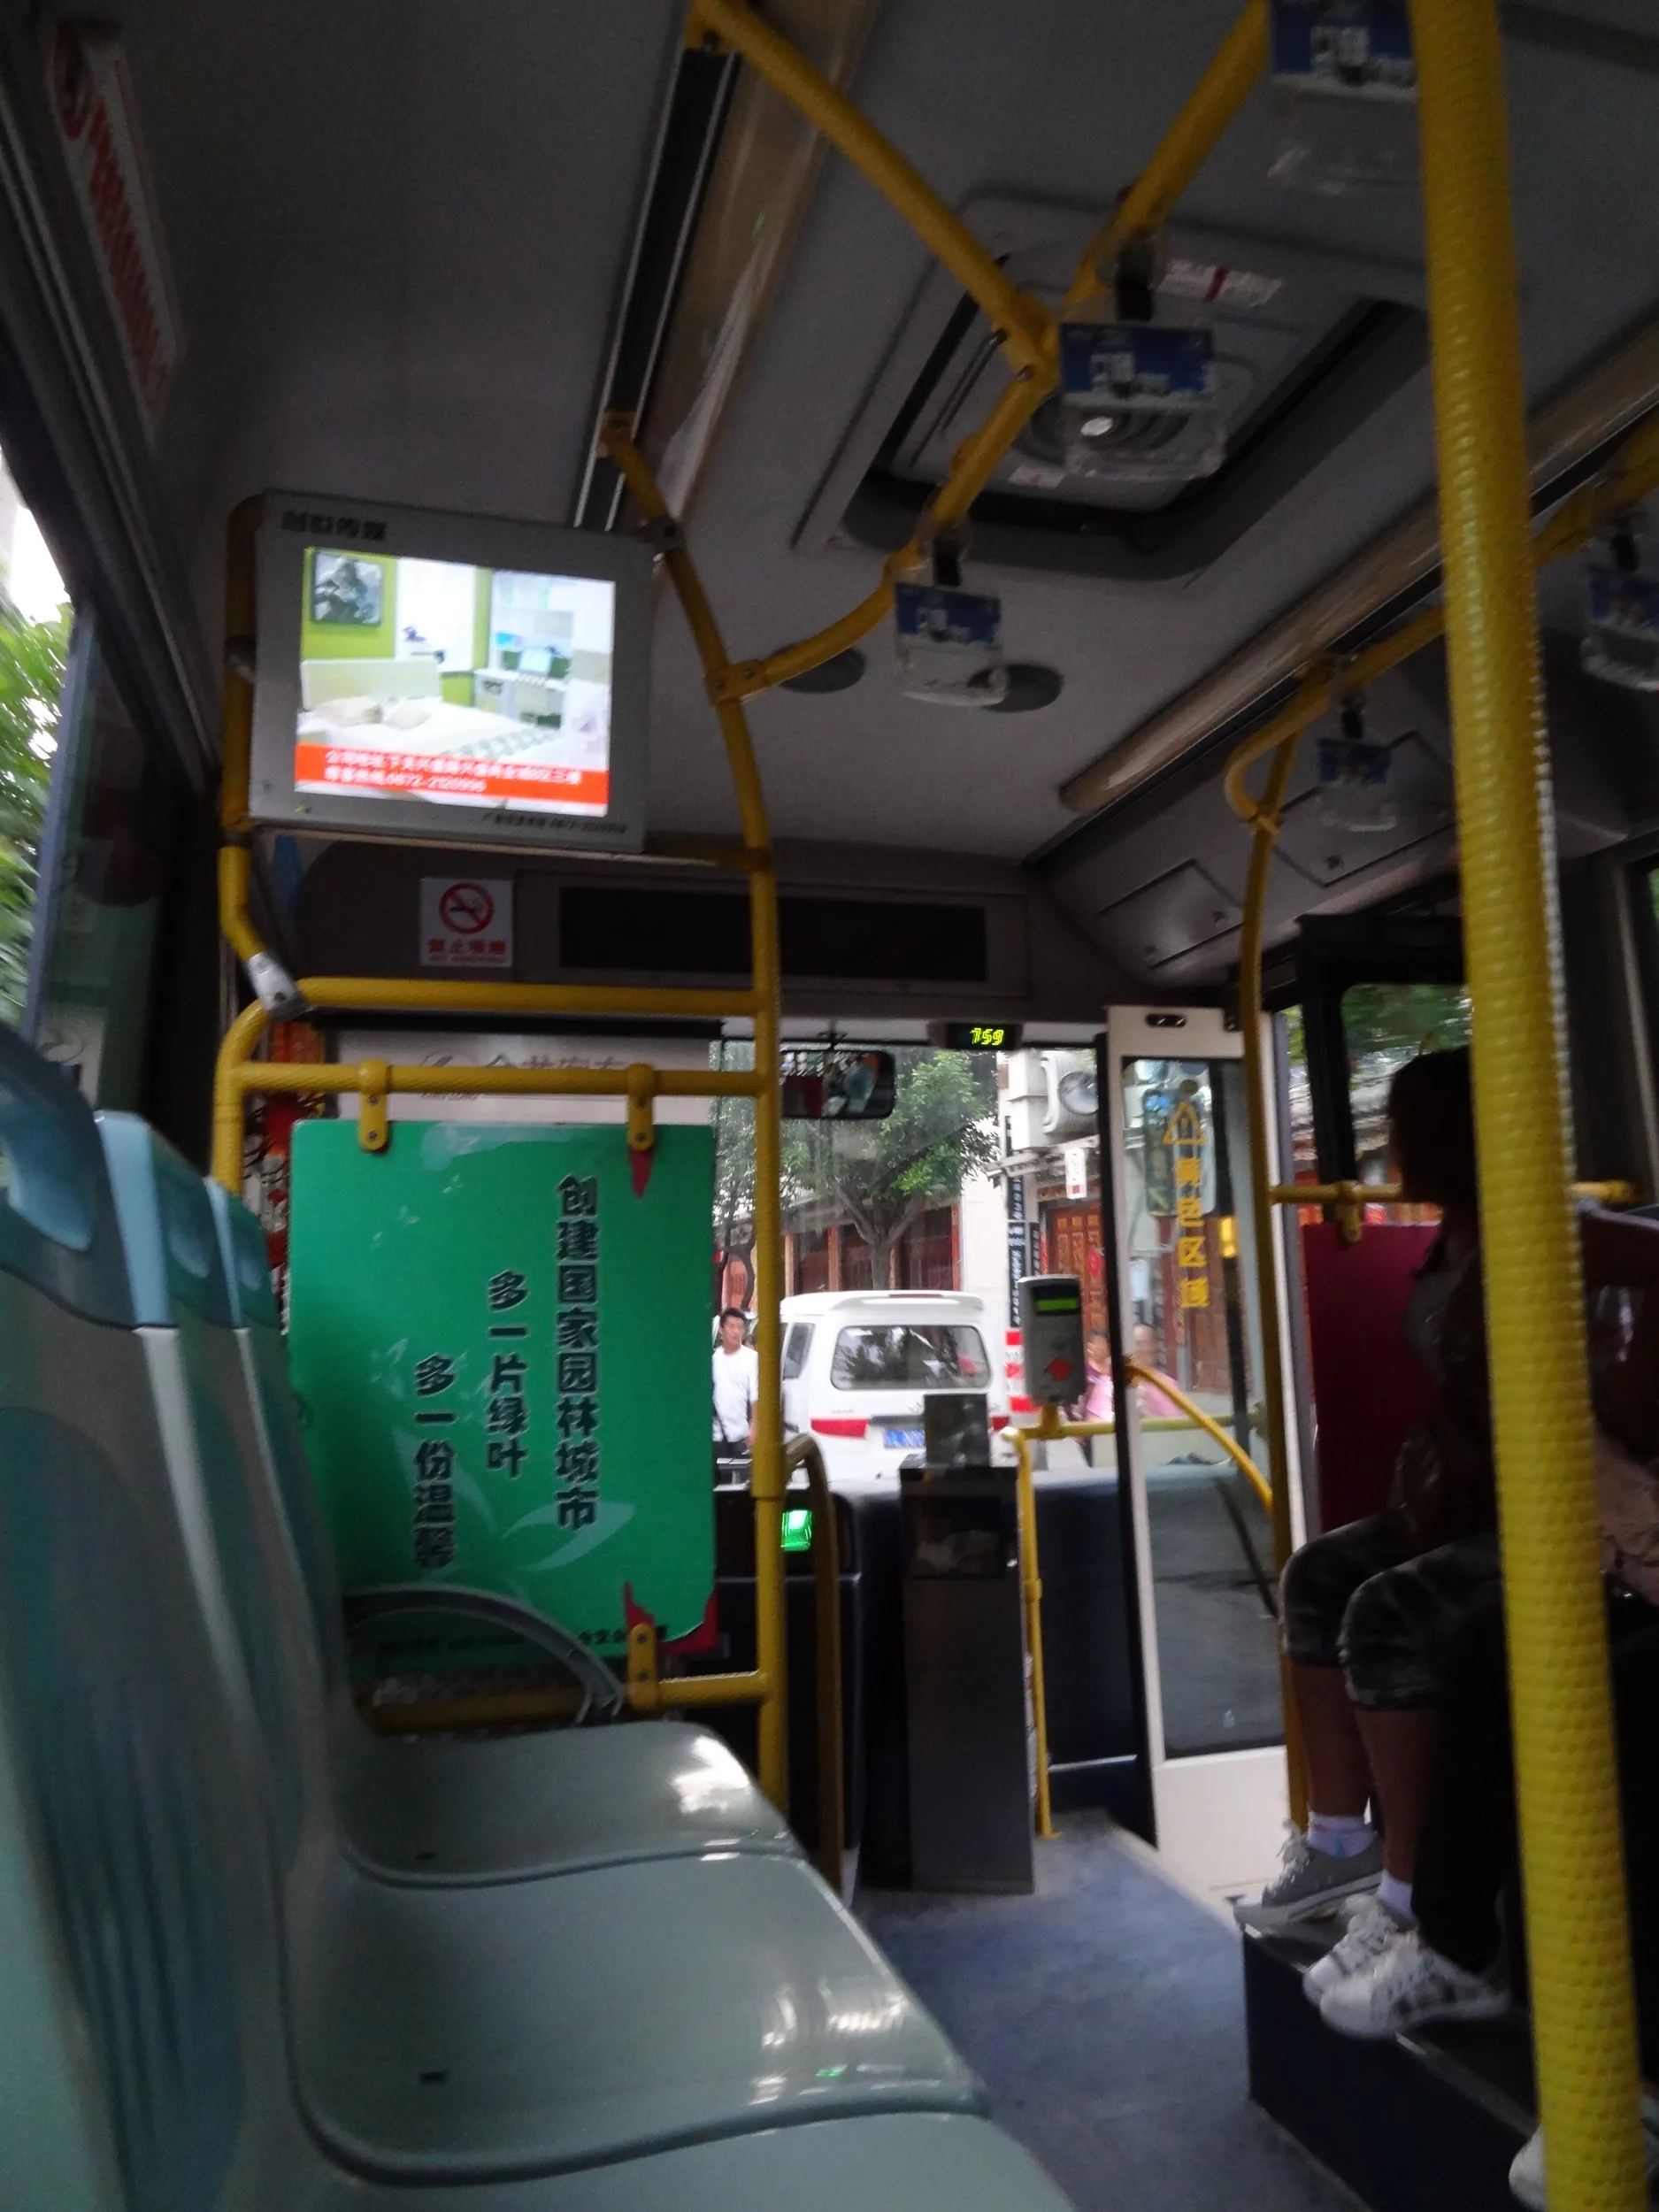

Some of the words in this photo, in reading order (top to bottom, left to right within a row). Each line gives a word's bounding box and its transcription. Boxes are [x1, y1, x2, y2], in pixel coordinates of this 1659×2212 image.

[487, 1269, 529, 1479] 多一片绿叶
[556, 1174, 600, 1532] 创建国家园林城市
[413, 1354, 457, 1570] 多一份温馨
